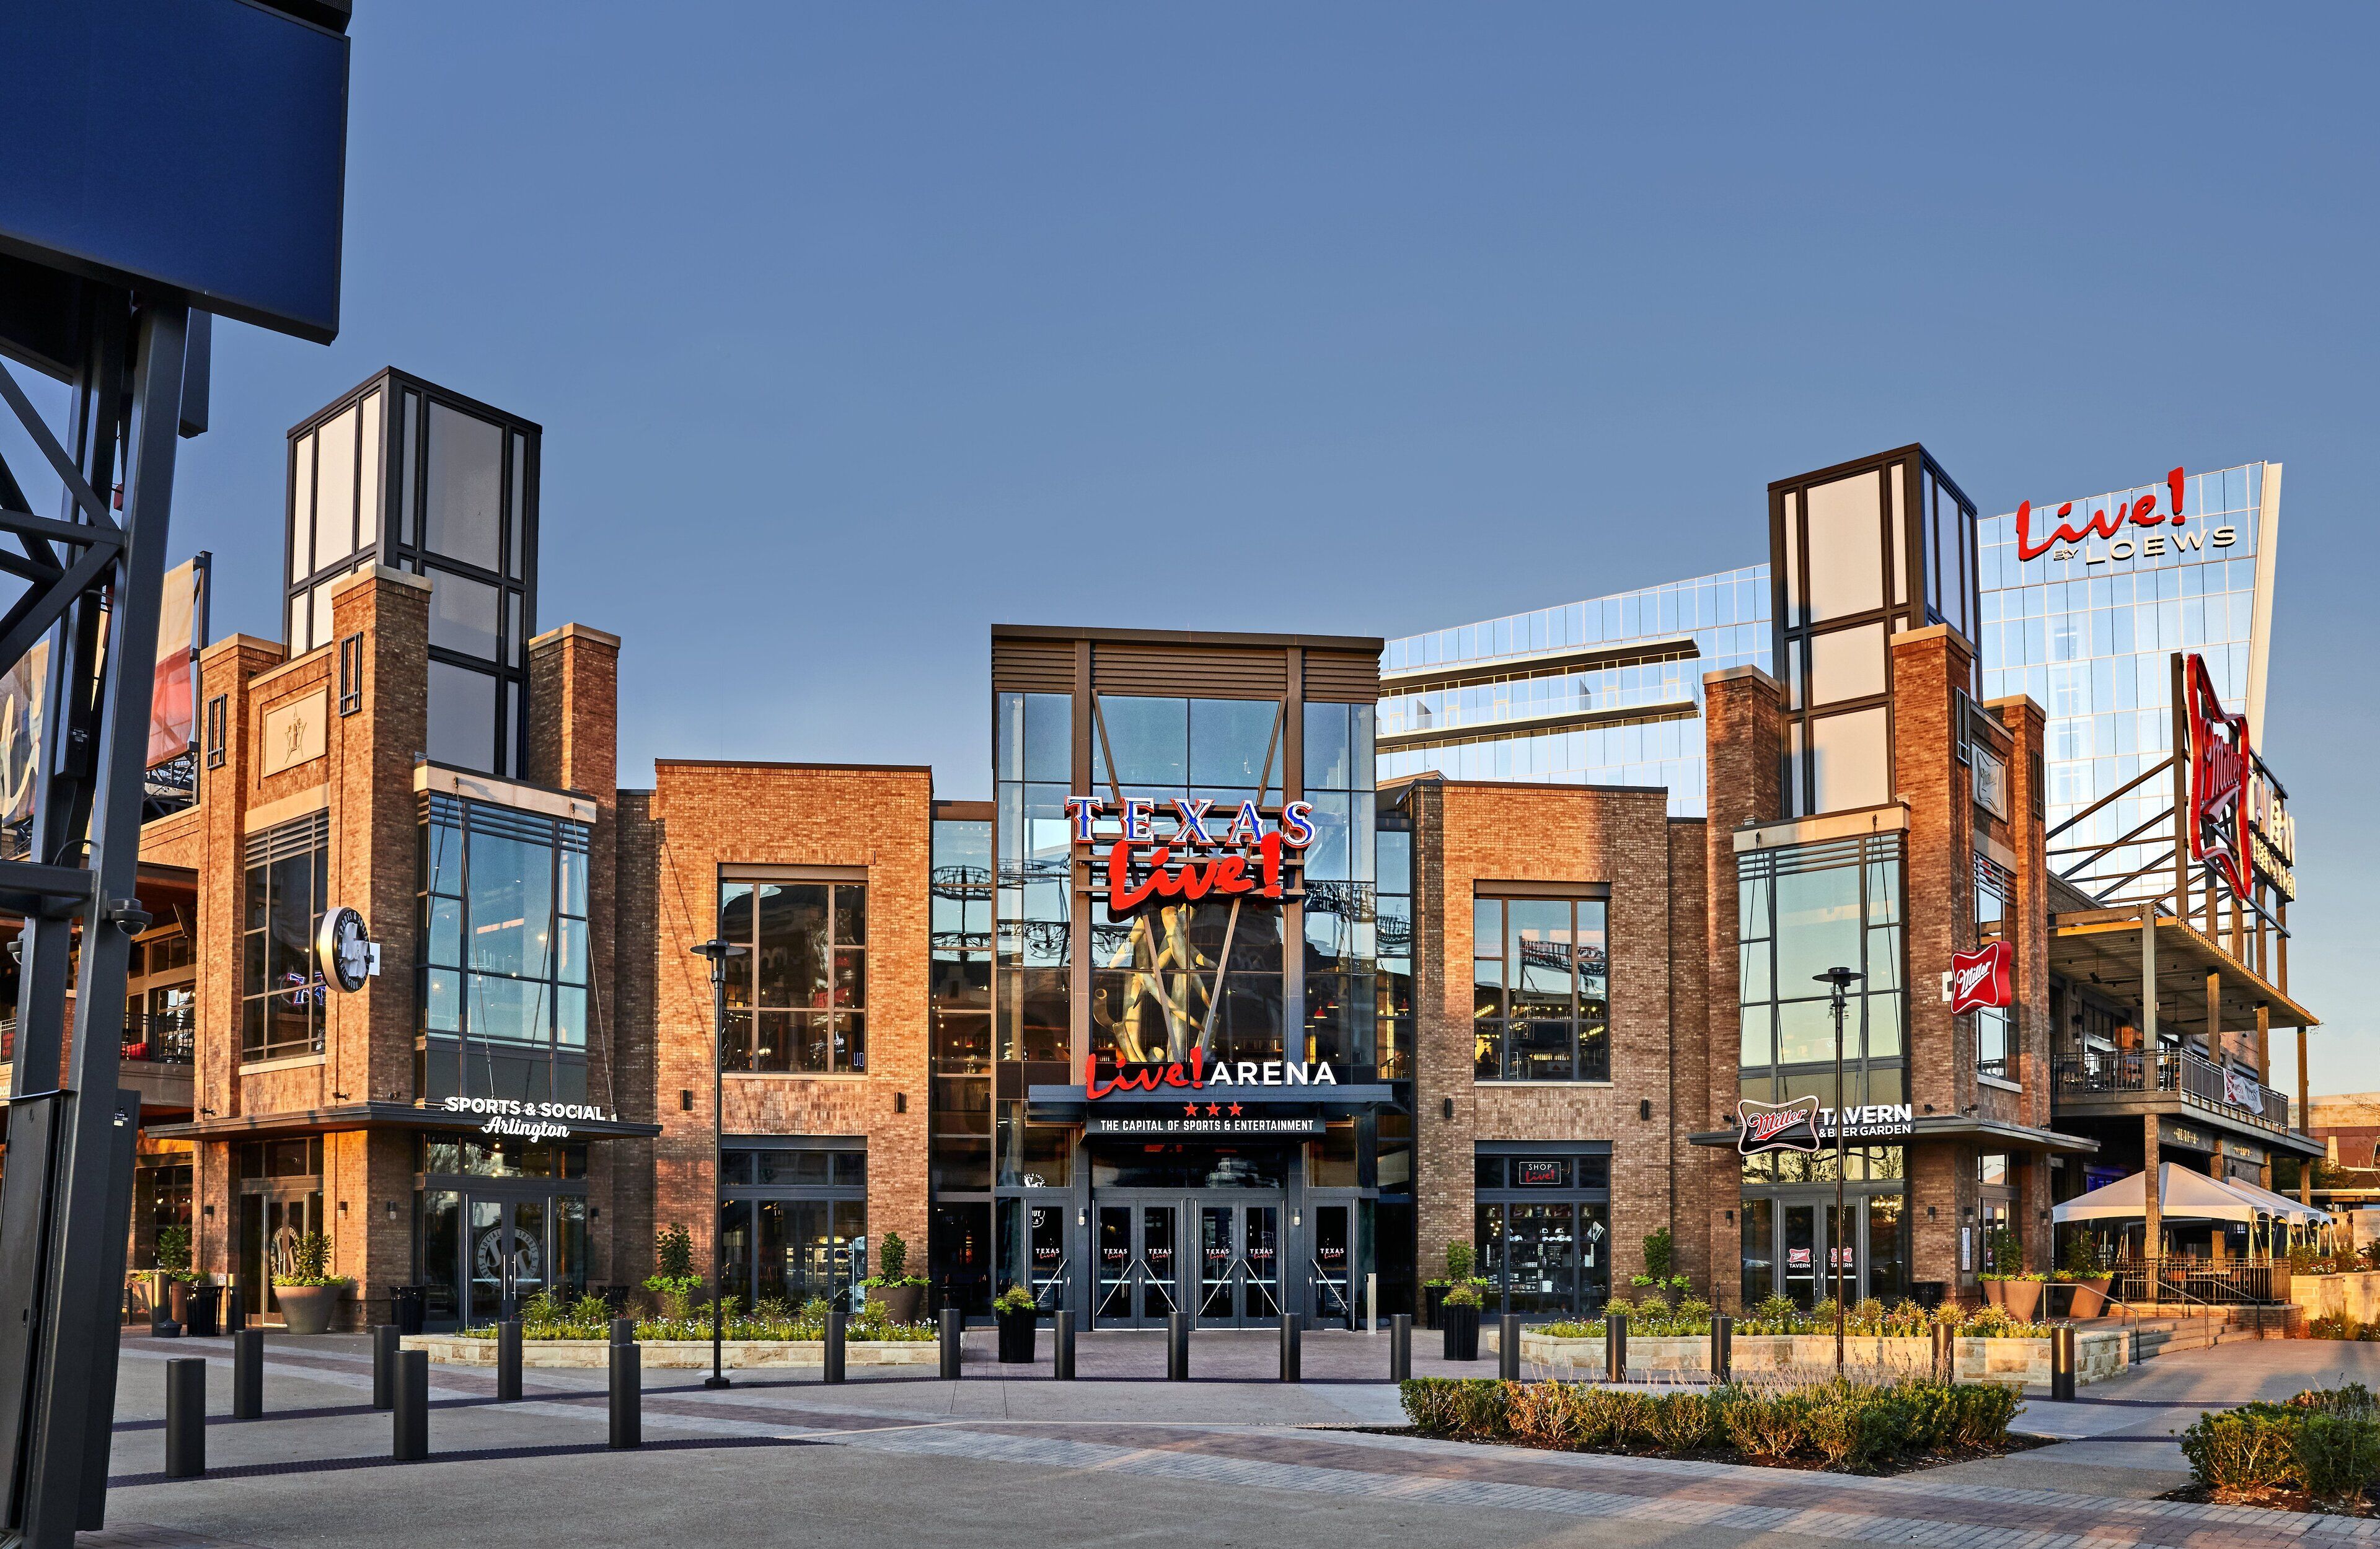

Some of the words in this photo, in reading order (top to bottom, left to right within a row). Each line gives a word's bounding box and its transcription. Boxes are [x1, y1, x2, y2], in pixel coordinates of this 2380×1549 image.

[2016, 466, 2186, 561] Live!
[2053, 546, 2078, 560] BY
[2086, 525, 2237, 565] LOEWS
[2203, 717, 2243, 799] Miller
[1065, 796, 1316, 849] TEXAS
[1109, 832, 1282, 911] Live!
[339, 911, 352, 937] SPORTS
[358, 916, 368, 941] SOCIA
[1956, 961, 1992, 994] Miller
[1085, 1046, 1204, 1100] Live!
[1209, 1061, 1337, 1086] ARENA
[445, 1096, 521, 1115] SPORTS
[524, 1102, 537, 1116] &
[539, 1102, 606, 1121] SOCIAL
[1747, 1108, 1809, 1138] Miller
[480, 1115, 570, 1143] Arlington
[1101, 1120, 1119, 1131] THE
[1122, 1120, 1163, 1131] CAPITAL
[1168, 1120, 1179, 1131] OF
[1183, 1120, 1220, 1131] SPORTS
[1224, 1120, 1230, 1131] &
[1235, 1120, 1314, 1131] ENTERTAINMENT
[1818, 1128, 1826, 1138] &
[1828, 1126, 1858, 1138] BER
[1860, 1124, 1911, 1136] GARDEN
[1525, 1169, 1554, 1182] Live!
